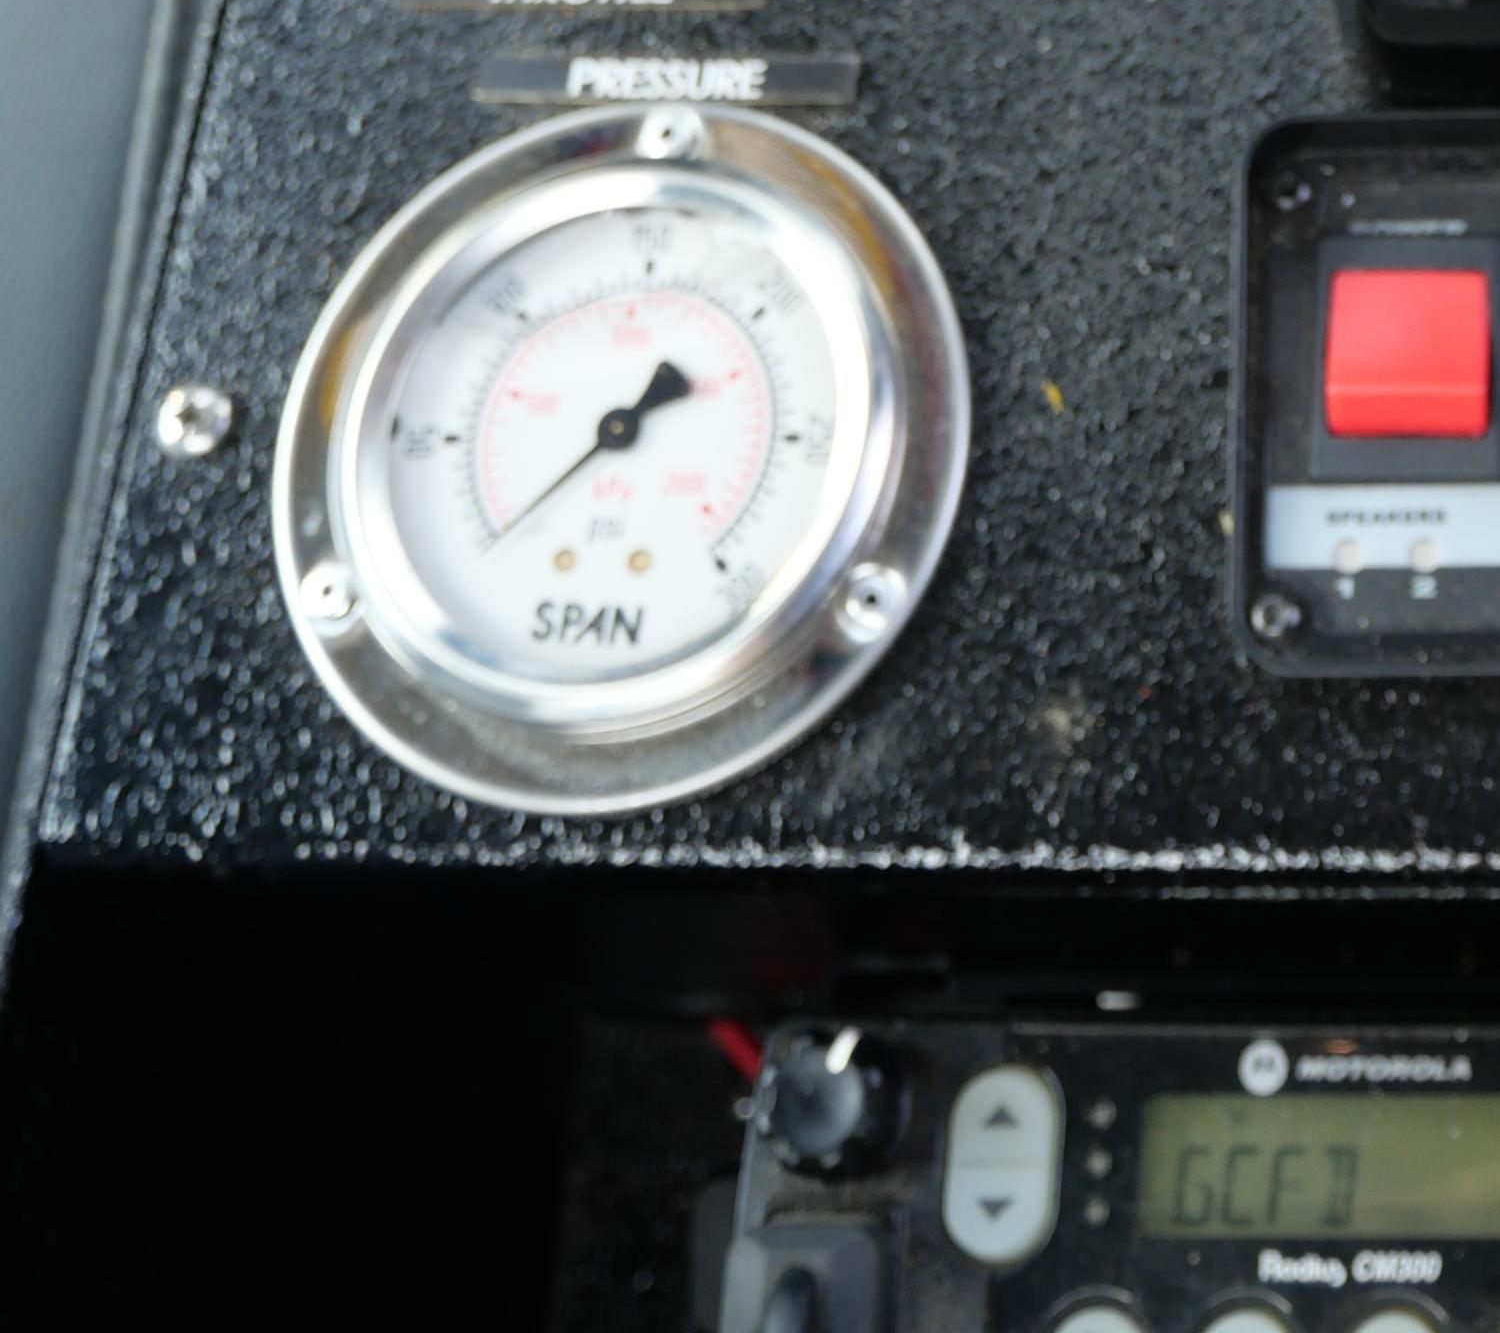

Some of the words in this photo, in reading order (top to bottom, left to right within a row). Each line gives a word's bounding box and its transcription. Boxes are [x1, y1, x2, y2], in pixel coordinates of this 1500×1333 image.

[565, 57, 769, 101] PRESSURE
[1326, 508, 1447, 526] SPEAKERS
[1333, 576, 1355, 600] 1
[1410, 576, 1438, 600] 2
[531, 601, 645, 646] SPAN
[1295, 1054, 1473, 1082] MOTOROLA
